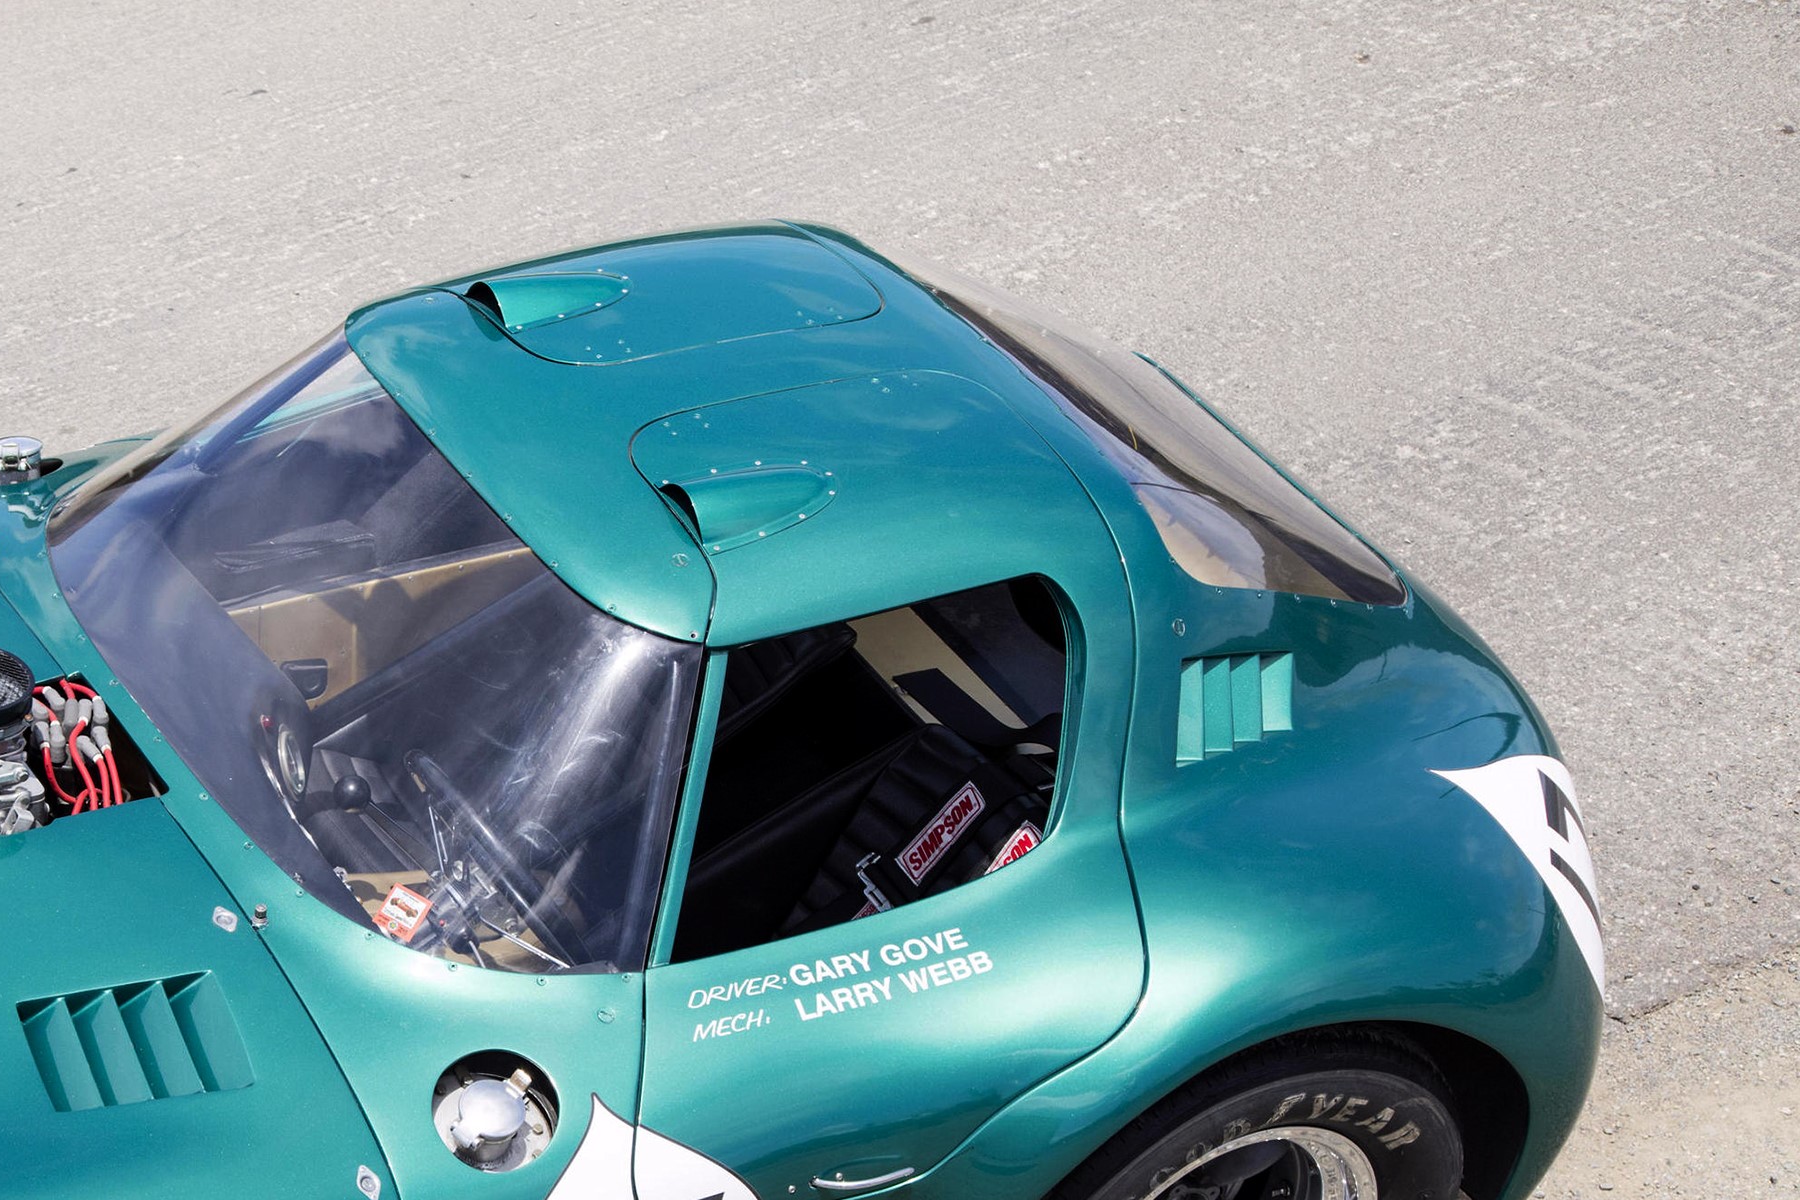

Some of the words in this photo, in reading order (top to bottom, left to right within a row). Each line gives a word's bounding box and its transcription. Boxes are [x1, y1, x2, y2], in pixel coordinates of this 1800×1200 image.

[908, 794, 975, 872] SIMPSON
[688, 974, 788, 1009] DRIVER:
[789, 949, 871, 987] GARY
[880, 927, 969, 967] GOVE
[794, 976, 893, 1022] LARRY
[897, 950, 994, 994] WEBB
